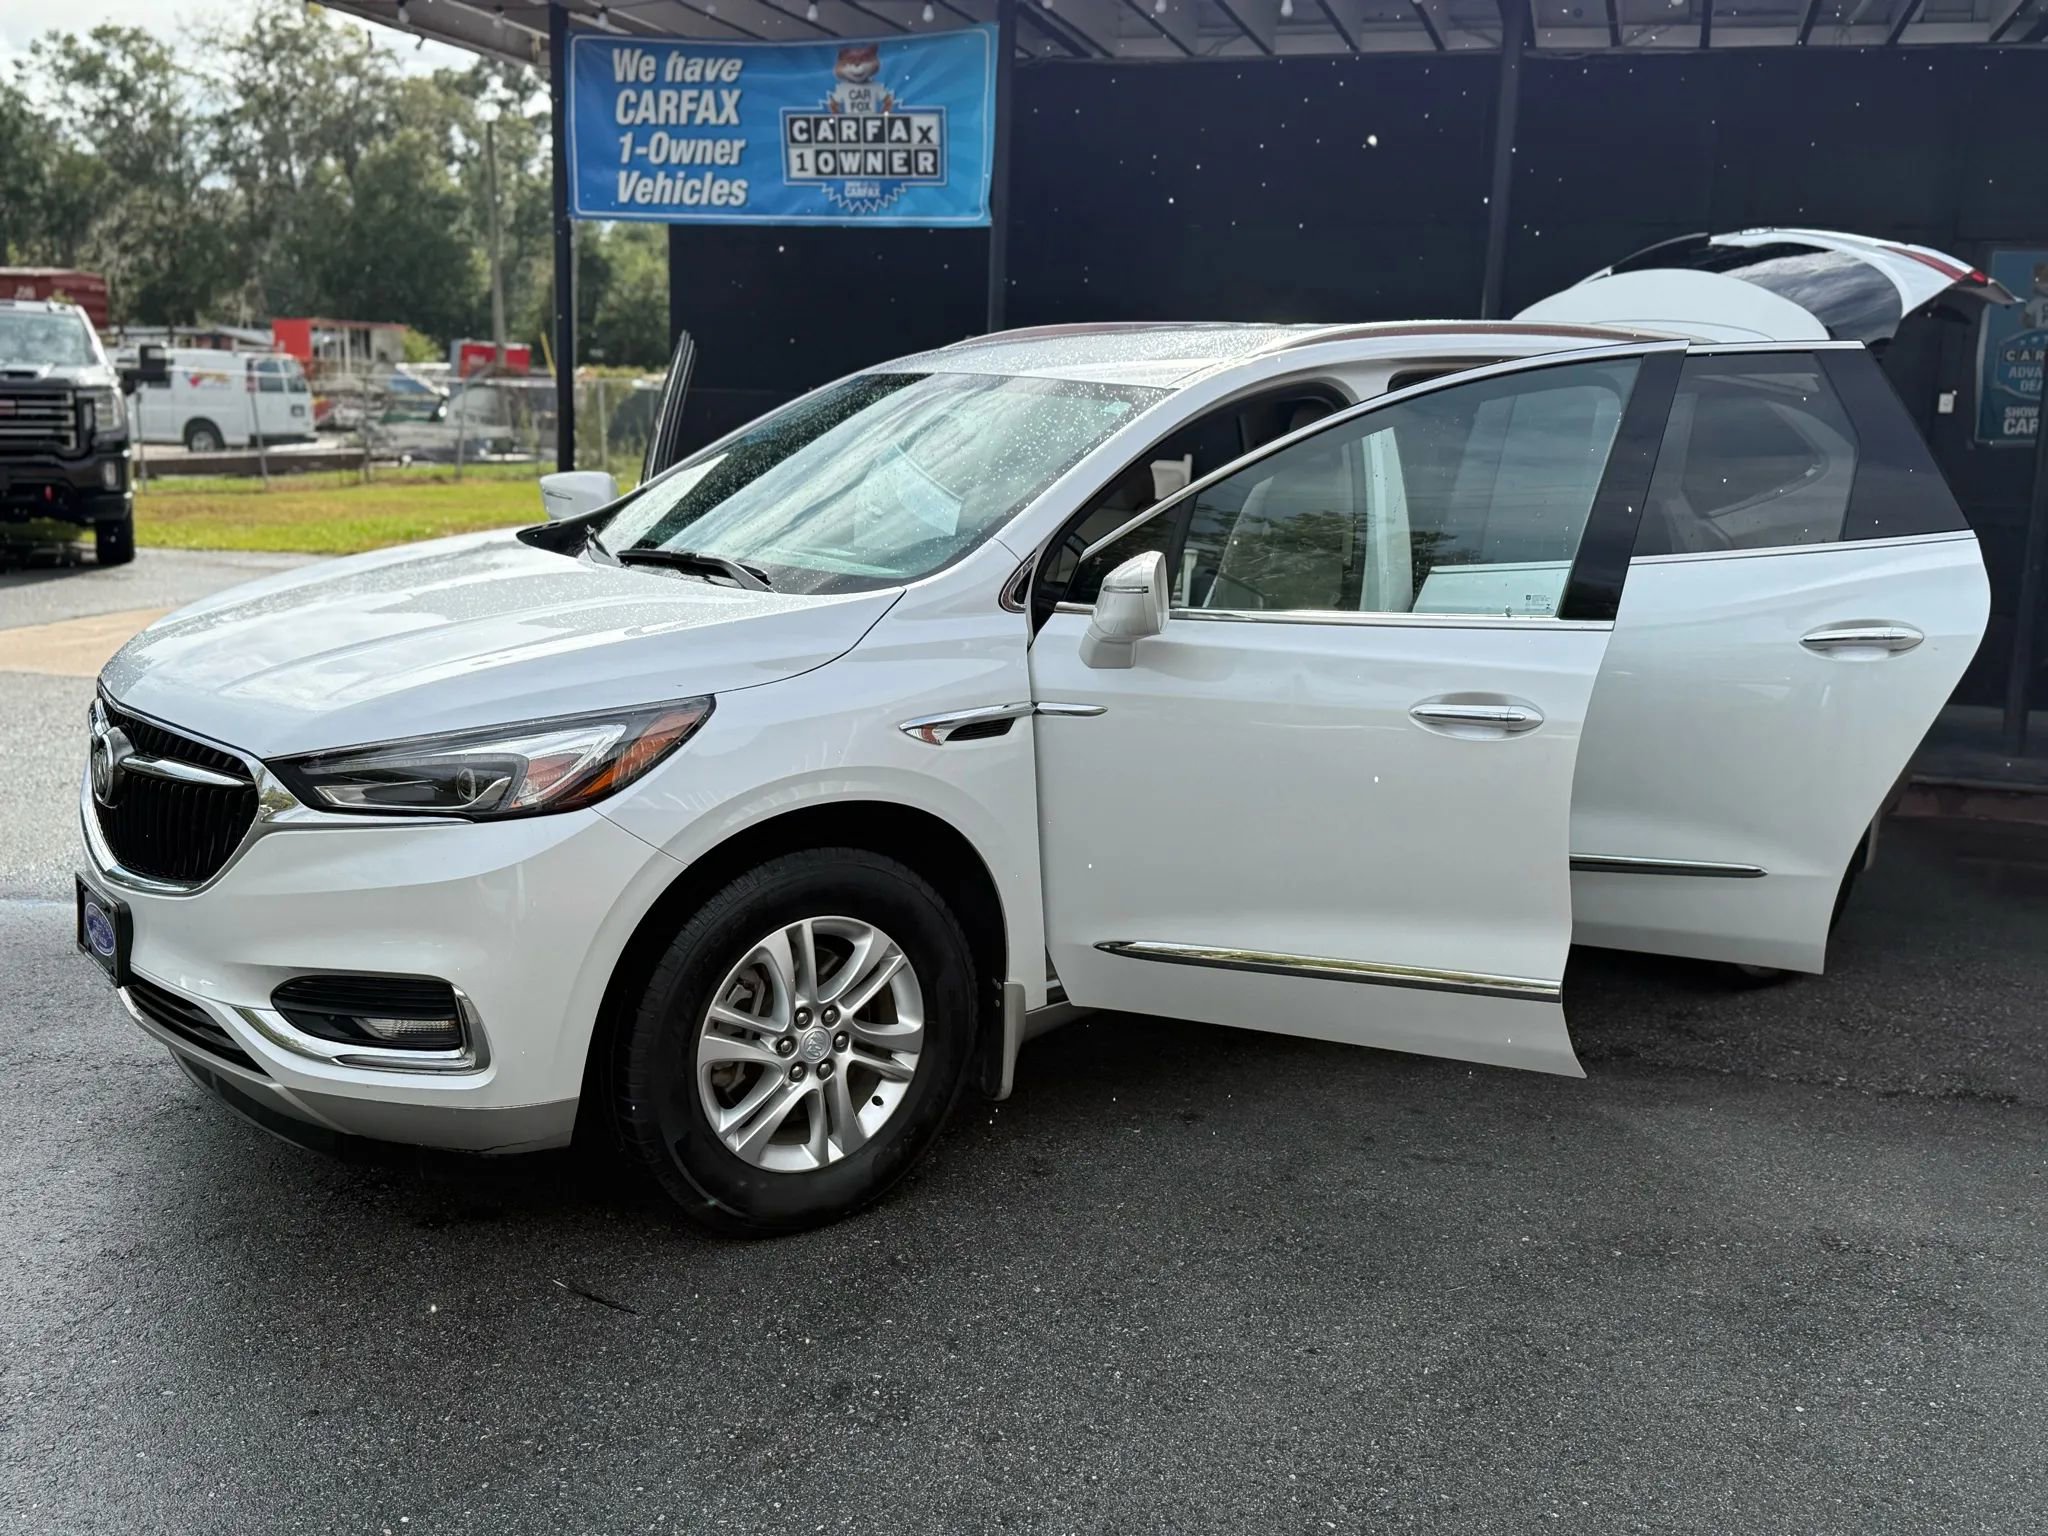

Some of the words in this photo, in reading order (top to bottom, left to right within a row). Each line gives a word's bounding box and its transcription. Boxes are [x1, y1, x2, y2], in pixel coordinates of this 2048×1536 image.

[612, 48, 657, 83] We
[665, 50, 743, 83] have
[615, 88, 742, 125] CARFAX
[849, 89, 871, 100] CAR
[850, 102, 872, 112] FOX
[619, 130, 747, 165] 1-Owner
[792, 119, 934, 144] CARFAX
[617, 170, 749, 206] Vehicles
